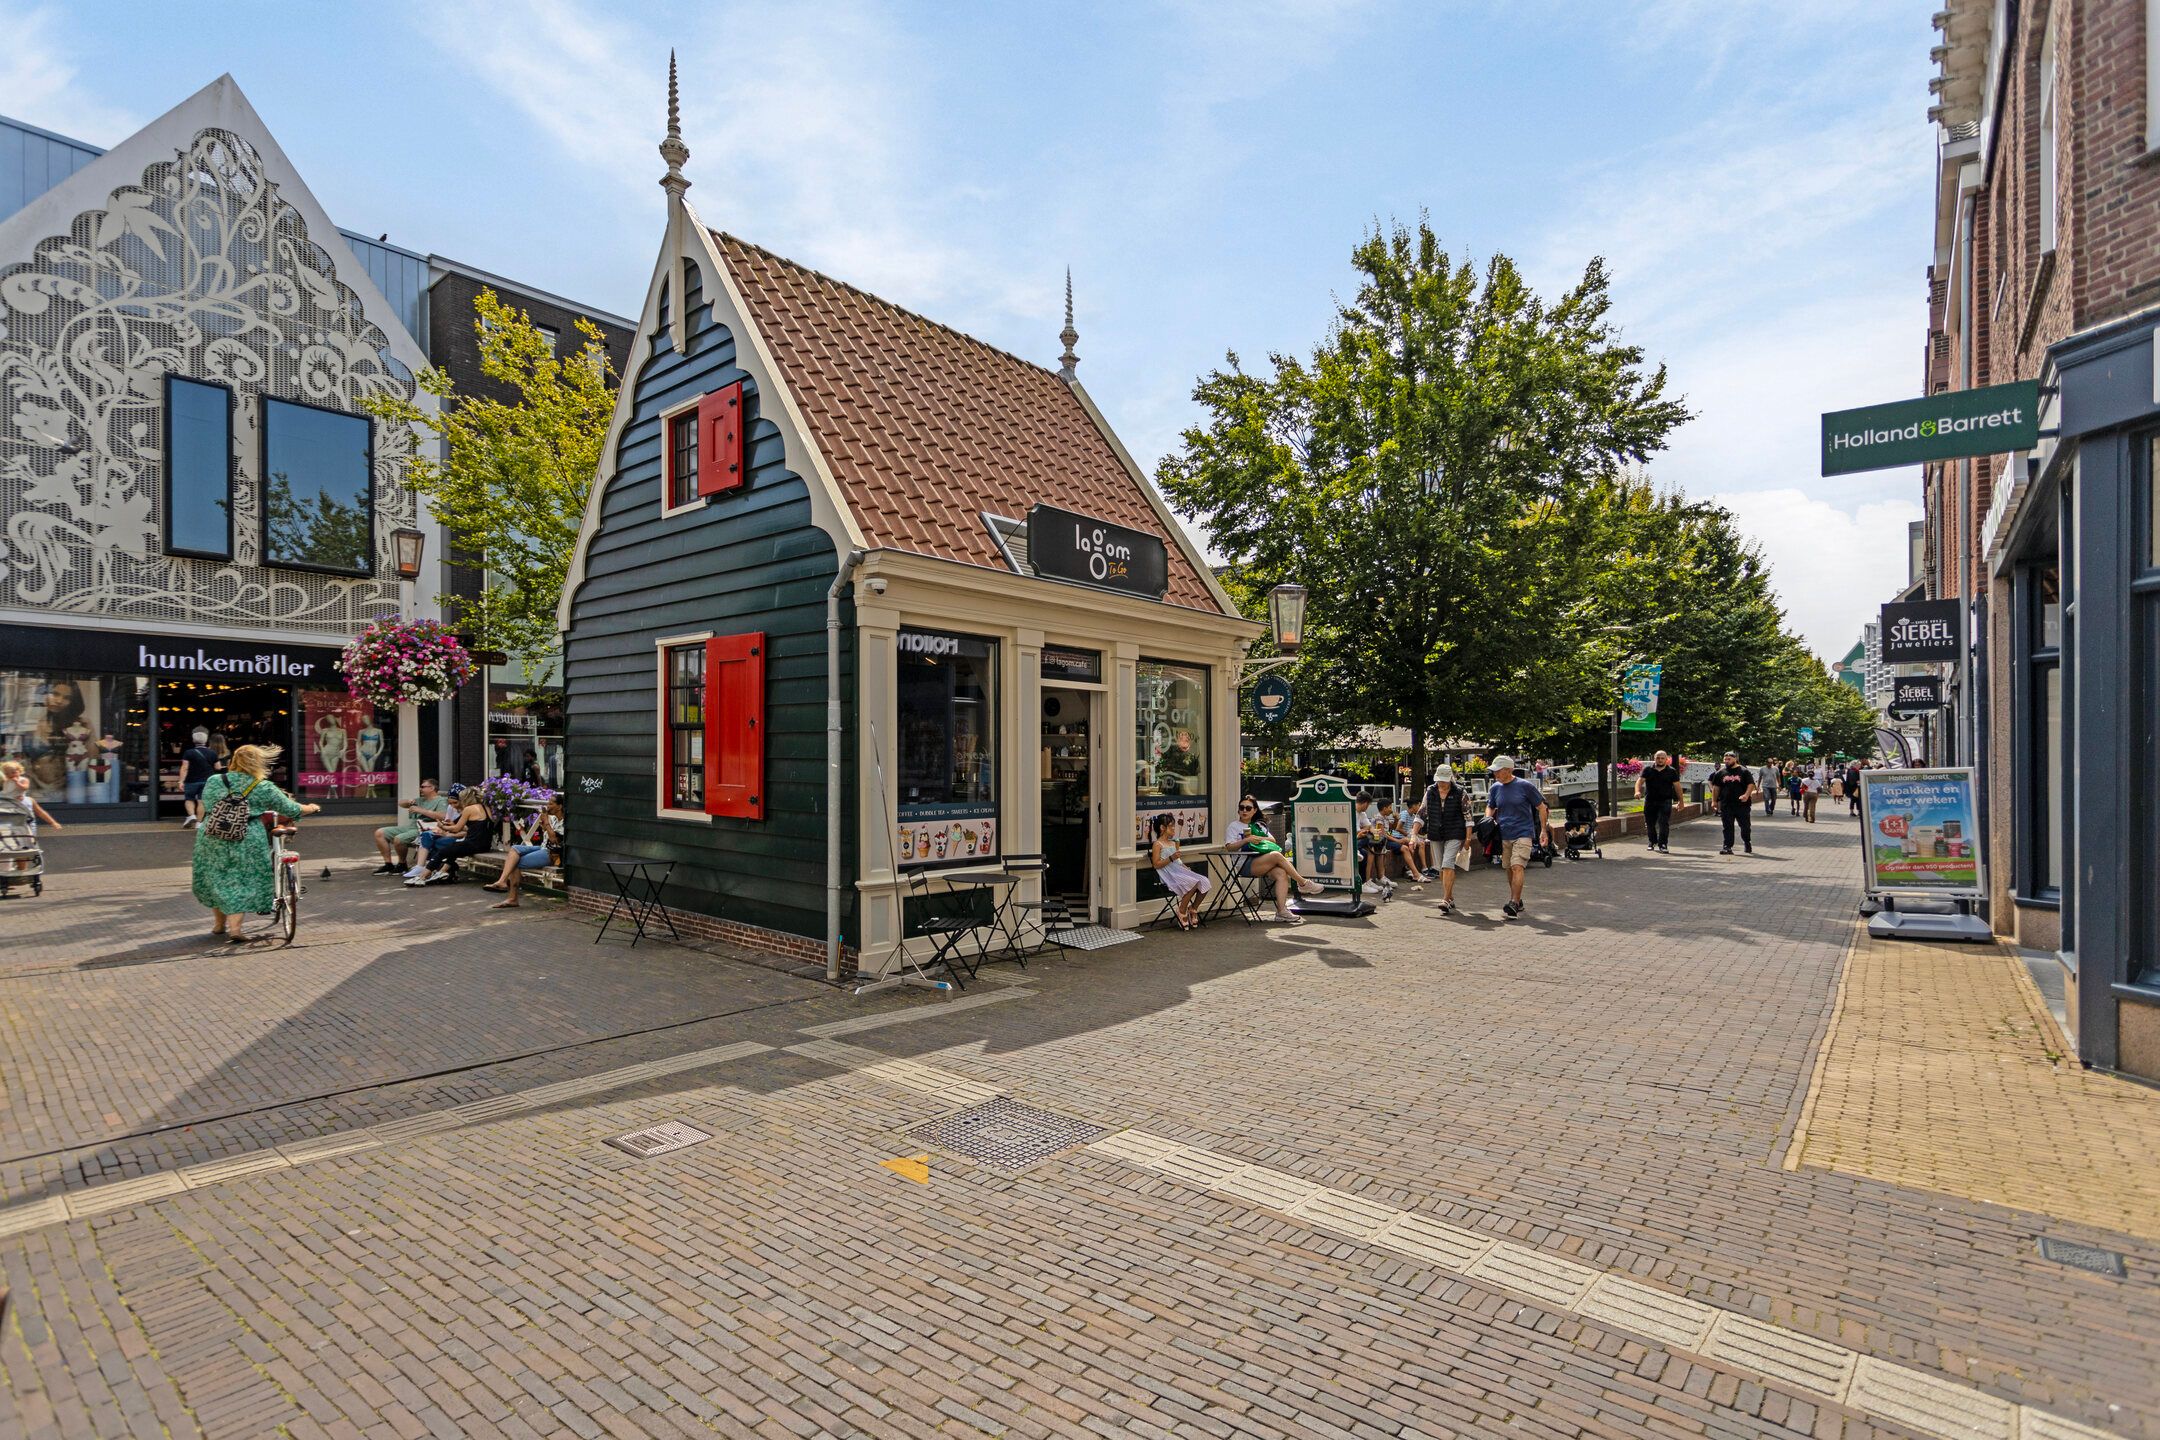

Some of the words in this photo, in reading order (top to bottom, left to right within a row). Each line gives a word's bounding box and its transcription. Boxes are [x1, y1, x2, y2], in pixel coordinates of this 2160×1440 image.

[1834, 408, 2022, 450] Holland&Barrett
[1075, 524, 1131, 580] lagom
[1890, 623, 1954, 642] SIEBEL
[139, 645, 316, 677] hunkemöller
[1898, 688, 1934, 699] SIEBEL
[302, 774, 337, 785] -50%
[354, 773, 388, 784] -50%
[1882, 786, 1940, 797] Inpakken
[1942, 785, 1960, 794] en
[1886, 798, 1912, 807] weg
[1914, 795, 1958, 804] weken
[1298, 805, 1348, 814] COFFEE
[1885, 819, 1904, 829] 1+1
